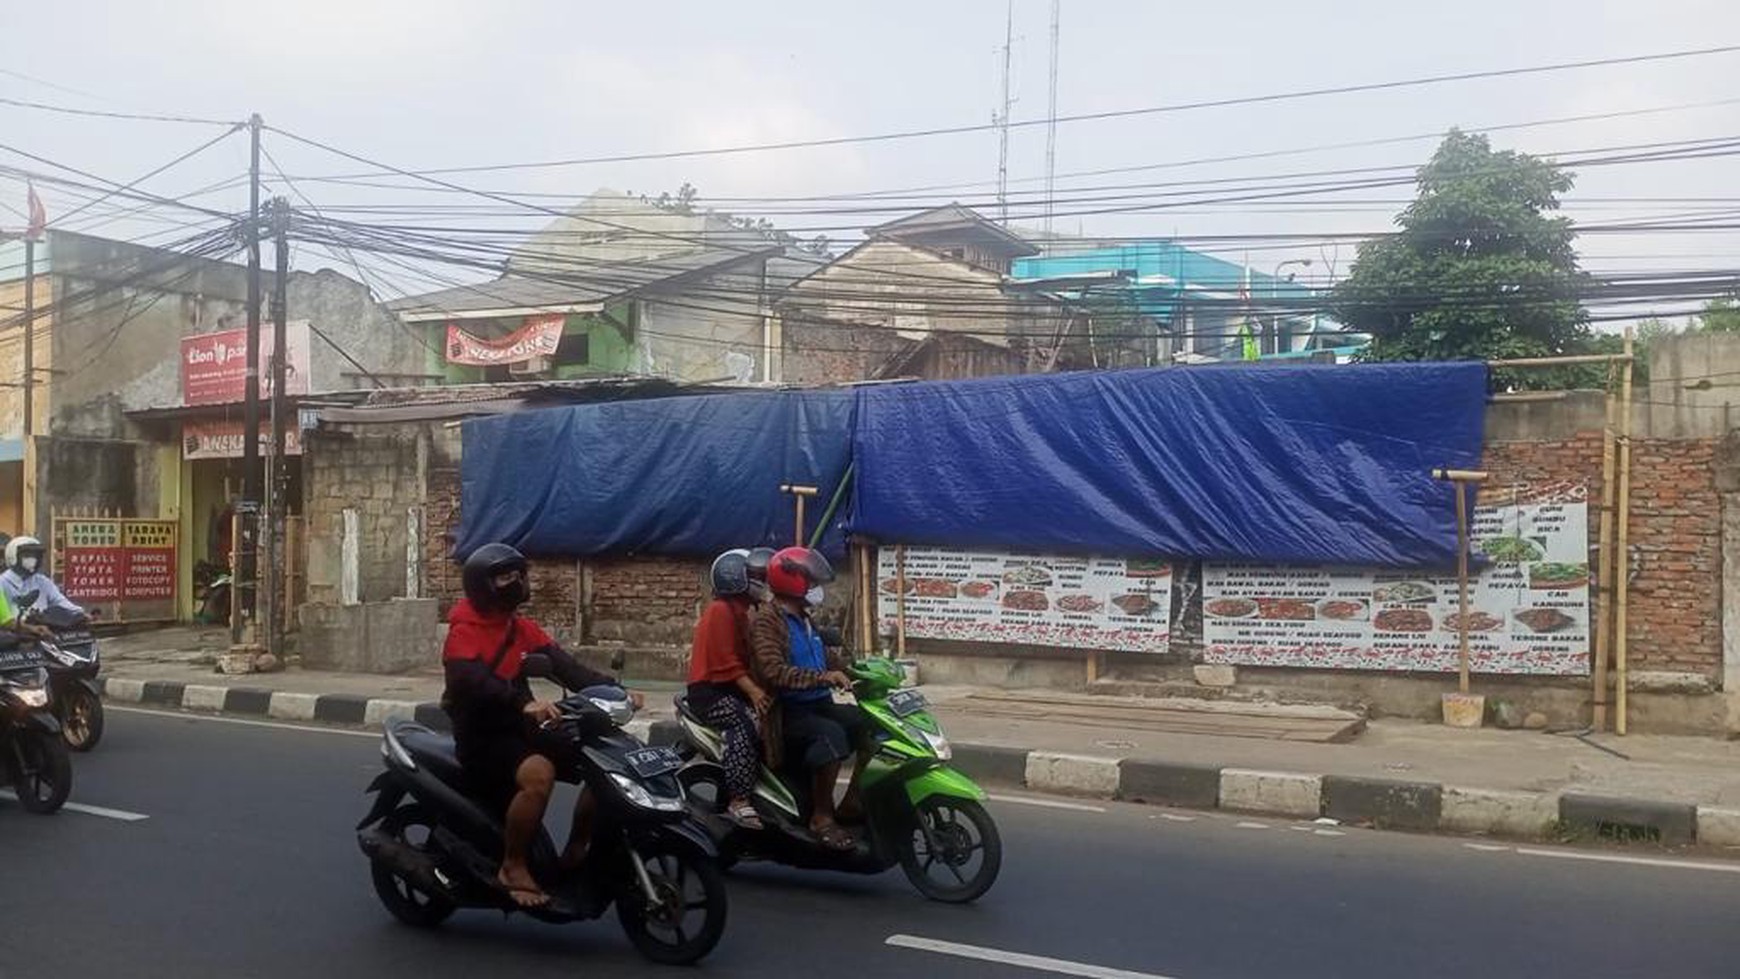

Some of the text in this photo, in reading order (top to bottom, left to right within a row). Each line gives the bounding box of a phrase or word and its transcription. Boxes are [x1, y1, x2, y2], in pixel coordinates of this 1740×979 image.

[190, 347, 214, 364] Lion
[71, 555, 116, 563] REFILL
[74, 565, 113, 574] TINTA
[73, 577, 114, 586] TONER
[126, 576, 171, 585] FOTOCOPY
[65, 588, 119, 598] CARTRIDGE
[125, 586, 172, 596] KOMPUTER
